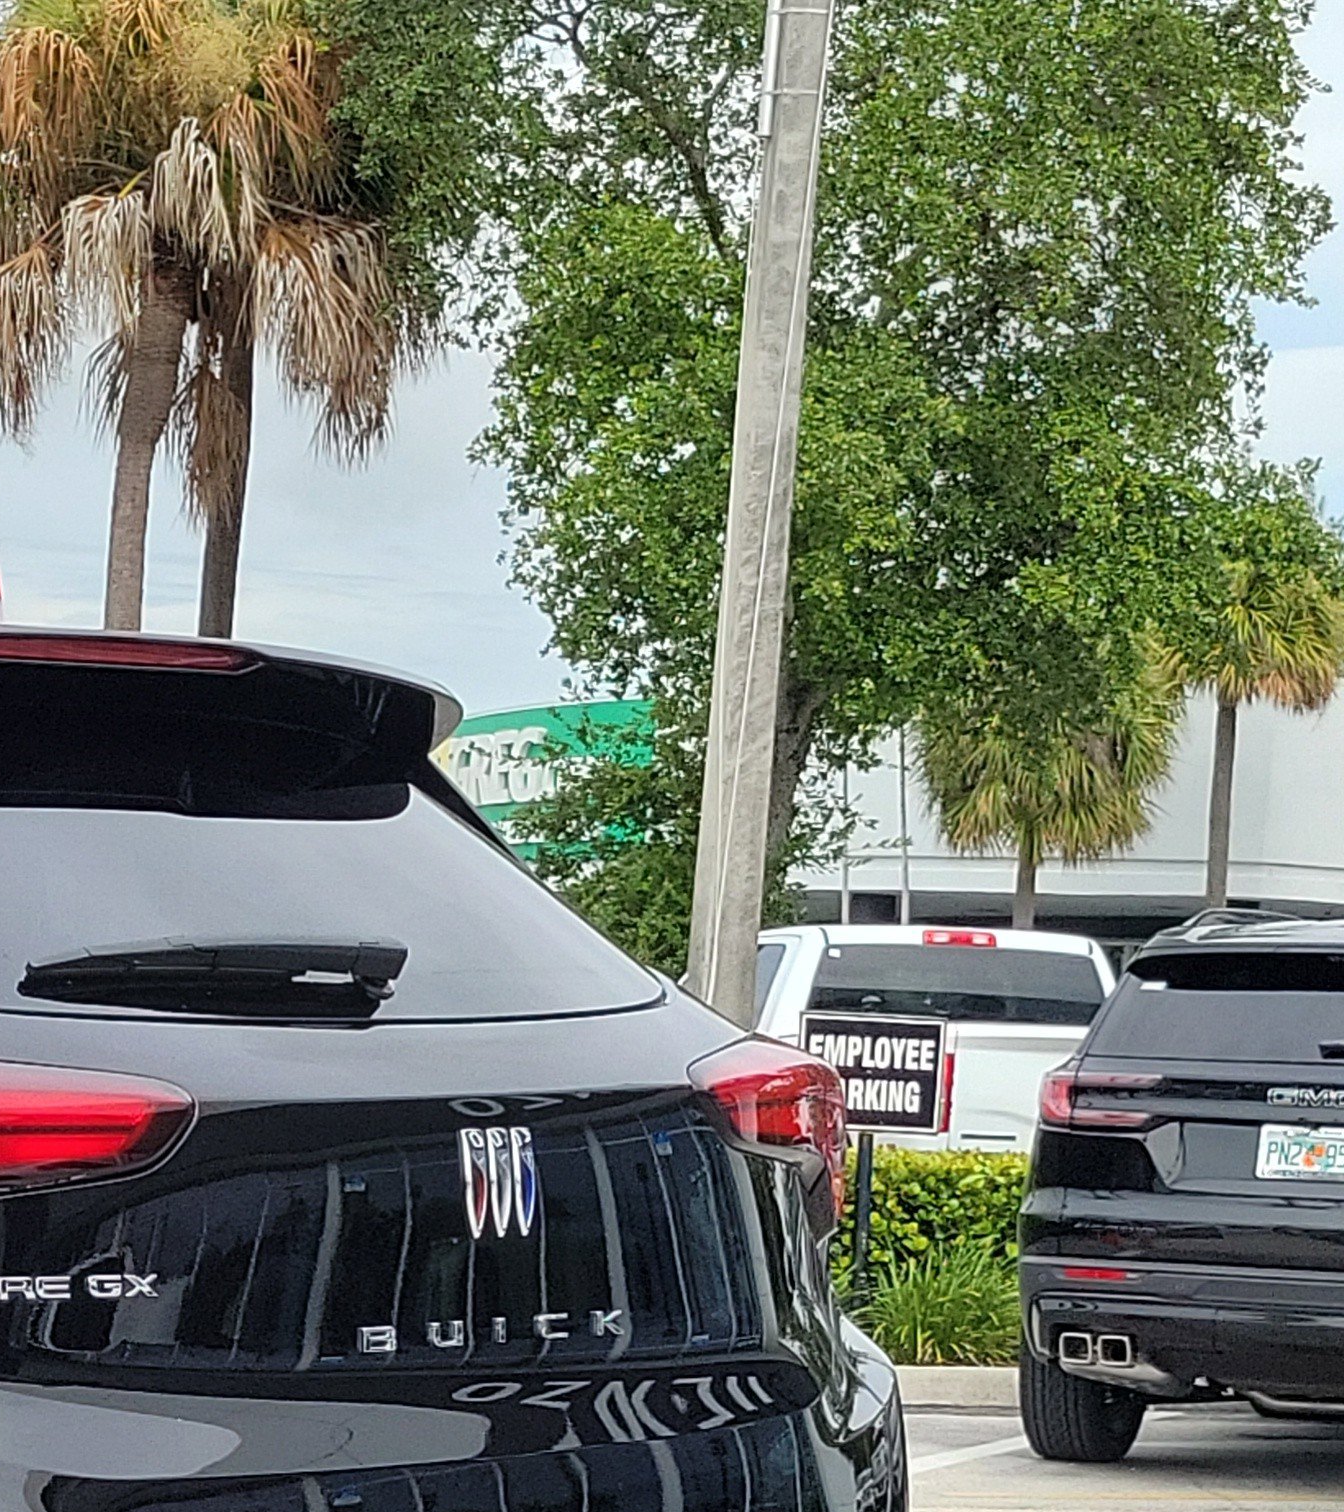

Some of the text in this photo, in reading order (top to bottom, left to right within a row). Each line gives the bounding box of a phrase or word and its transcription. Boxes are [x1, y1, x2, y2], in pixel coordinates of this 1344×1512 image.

[809, 1034, 936, 1071] EMPLOYEE
[844, 1078, 921, 1113] RKING
[86, 1273, 159, 1298] GX
[357, 1308, 625, 1353] BUICK
